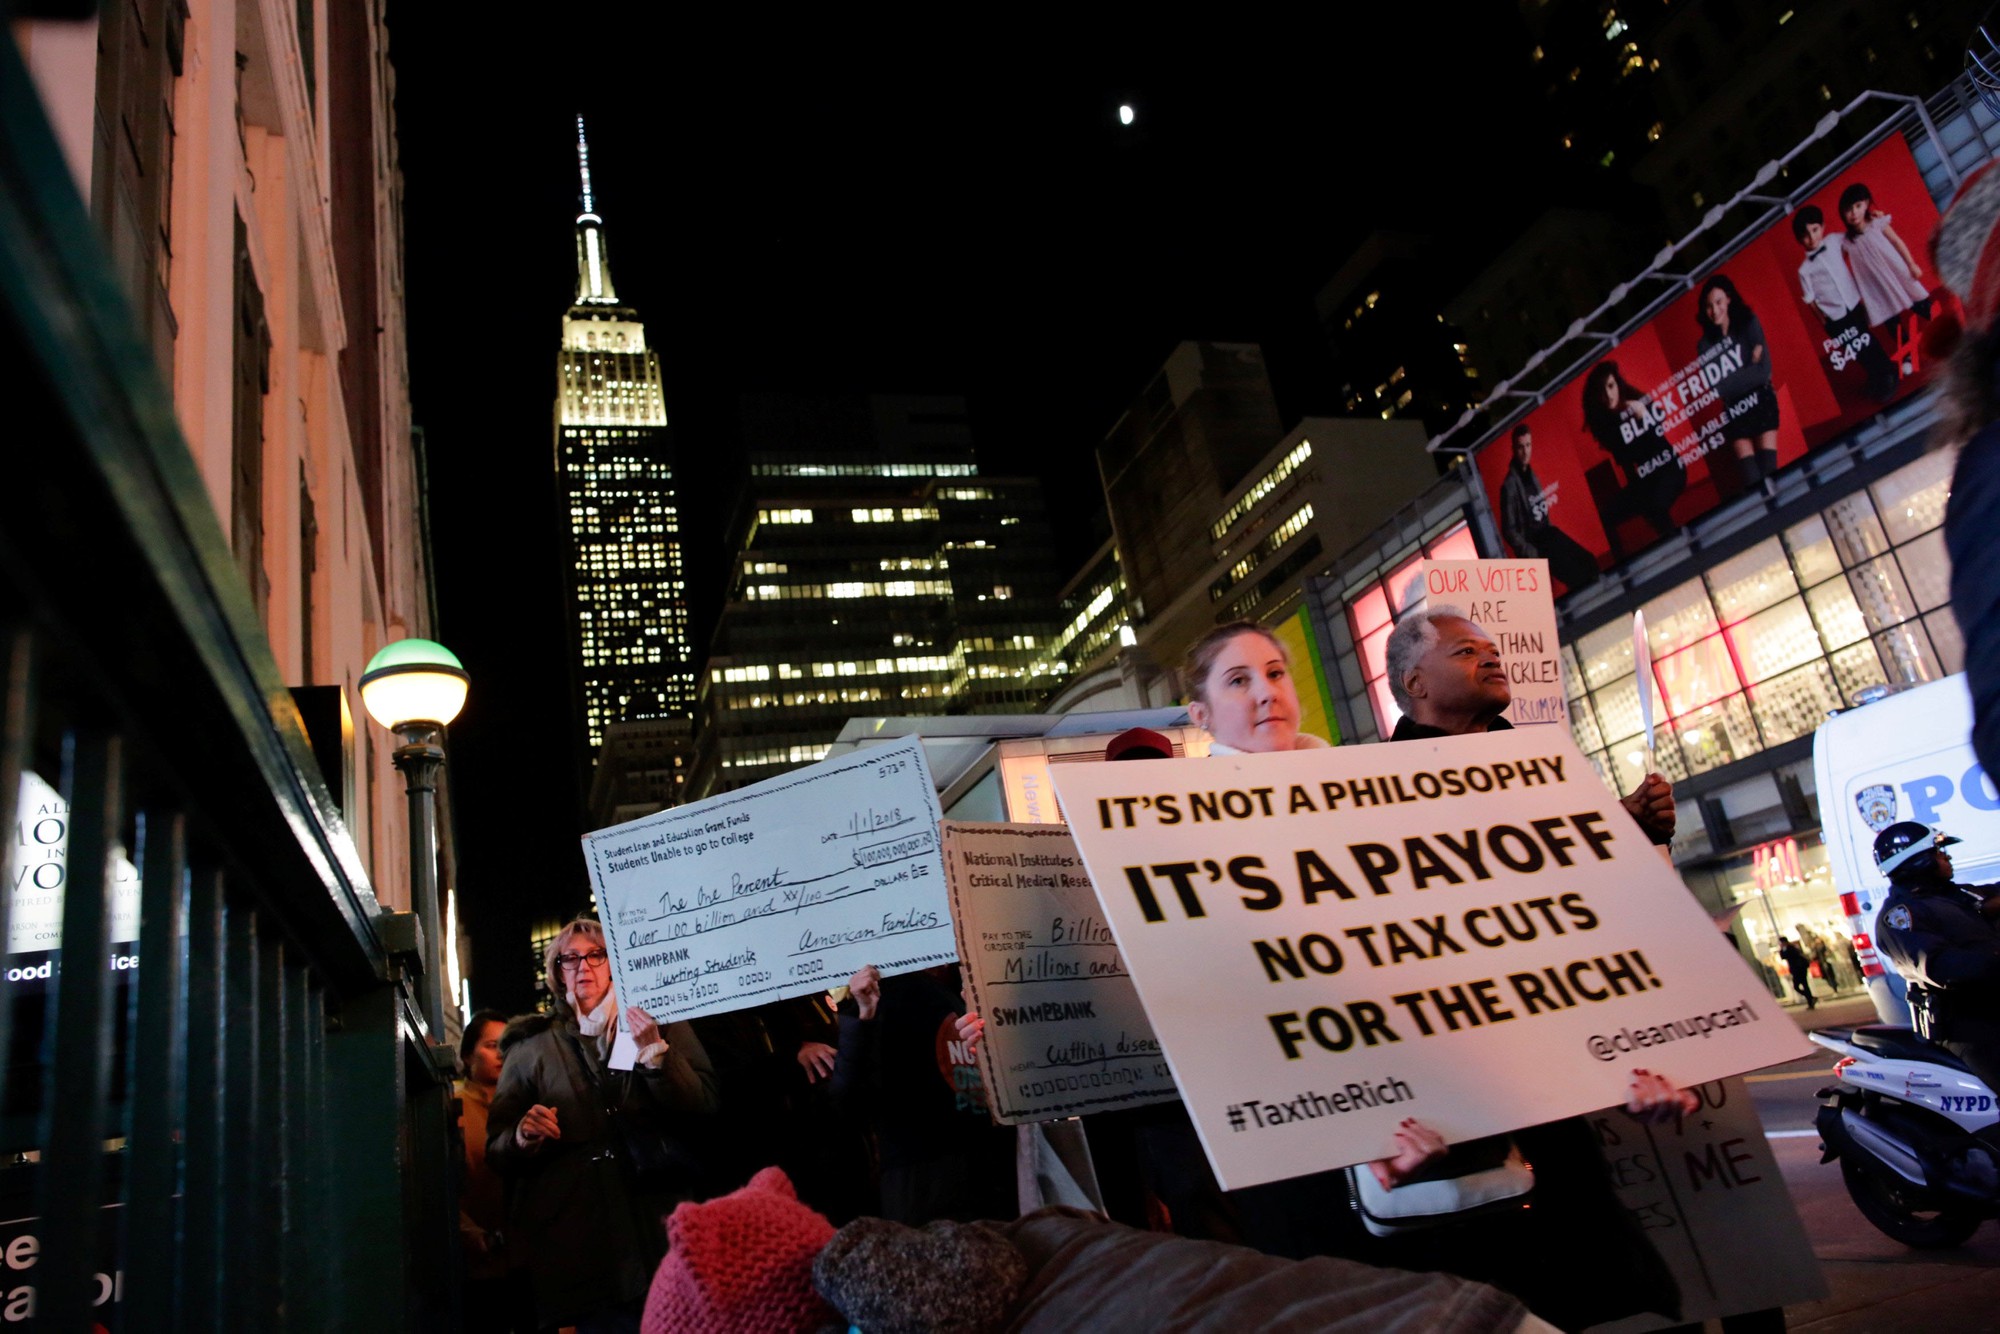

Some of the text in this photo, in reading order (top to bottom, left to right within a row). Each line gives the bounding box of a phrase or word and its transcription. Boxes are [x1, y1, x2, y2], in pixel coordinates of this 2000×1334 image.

[1823, 325, 1859, 353] Pants
[1620, 344, 1744, 445] BLACK FRIDAY
[1655, 387, 1720, 437] COLLECTION
[1637, 392, 1759, 479] DEALS AVAILABLE NOW
[1677, 432, 1726, 469] FROM $3
[1428, 566, 1539, 595] OUR VOTES
[1470, 600, 1508, 623] ARE
[1495, 632, 1544, 655] THAN
[1097, 755, 1567, 829] IT’S NOT A PHILOSOPHY
[604, 846, 633, 859] Student
[652, 834, 666, 848] and
[666, 828, 704, 843] Education
[705, 820, 726, 834] Grant
[727, 812, 750, 828] Funds
[608, 831, 754, 874] Students Unable to go to College
[964, 851, 1018, 867] National
[1020, 852, 1074, 868] Institutes
[969, 873, 1013, 888] Critical
[1016, 873, 1058, 889] Medical
[1123, 811, 1616, 925] IT’S A PAYOFF
[659, 867, 789, 914] The One Percent
[629, 929, 658, 948] Over
[668, 921, 687, 939] 100
[695, 910, 736, 933] billion
[743, 898, 775, 918] and
[799, 908, 939, 951] American Families
[982, 930, 1032, 941] PAY TO THE
[1251, 892, 1600, 983] NO TAX CUTS
[627, 948, 690, 972] SWAMPBANK
[704, 947, 757, 974] Students
[1005, 951, 1121, 980] Millions and
[1266, 949, 1663, 1061] FOR THE RICH!
[1586, 999, 1760, 1062] @cleanupcarl
[1226, 1076, 1415, 1133] #TaxtheRich
[1940, 1095, 1991, 1112] NYPD
[1684, 1137, 1762, 1191] ME
